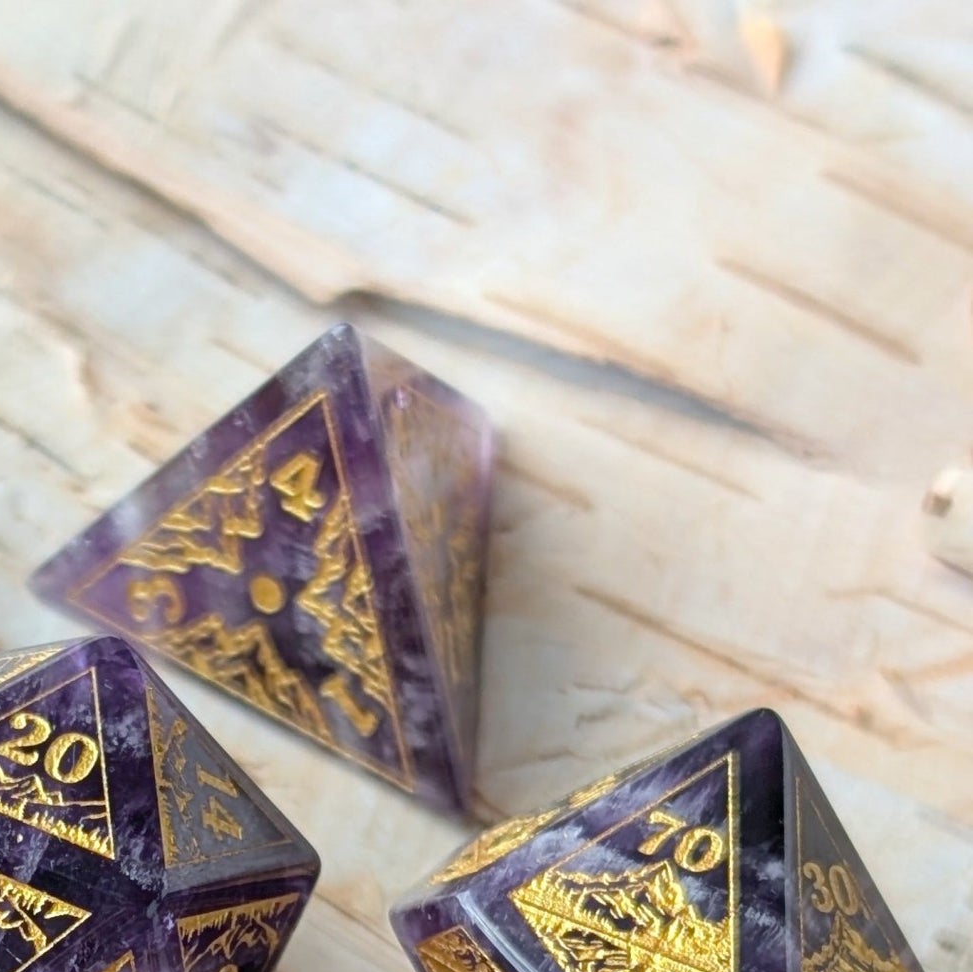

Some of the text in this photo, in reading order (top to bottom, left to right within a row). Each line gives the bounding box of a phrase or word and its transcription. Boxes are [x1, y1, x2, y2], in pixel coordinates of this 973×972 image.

[270, 452, 325, 522] 4
[130, 576, 186, 625] 3
[321, 673, 380, 738] 1
[195, 763, 244, 841] 14
[637, 811, 724, 874] 70
[802, 862, 859, 916] 30
